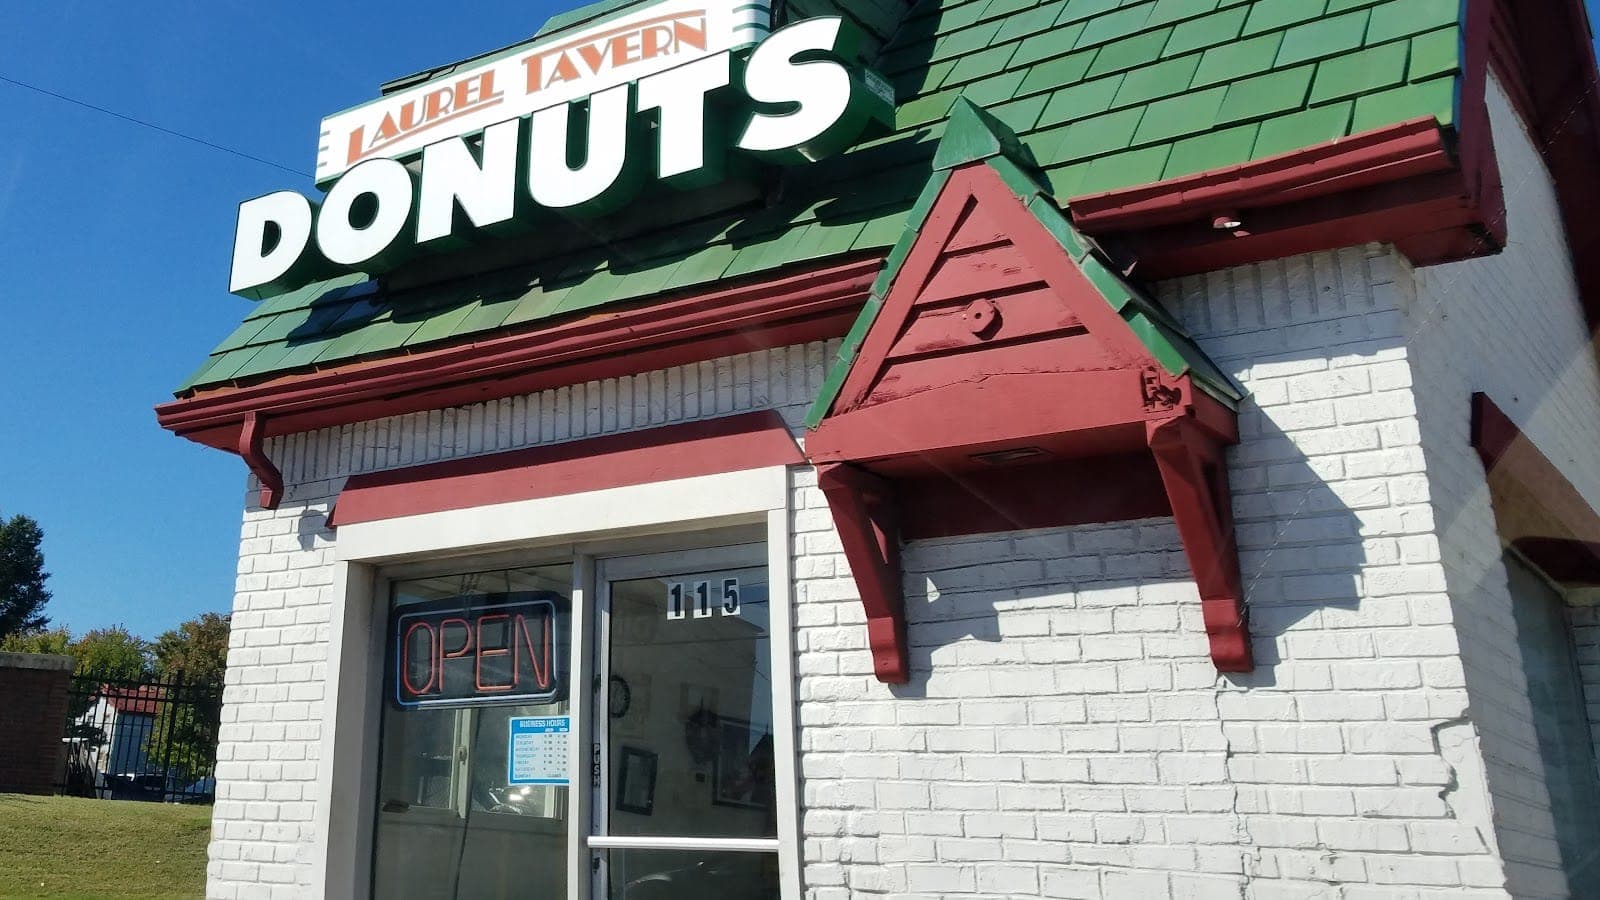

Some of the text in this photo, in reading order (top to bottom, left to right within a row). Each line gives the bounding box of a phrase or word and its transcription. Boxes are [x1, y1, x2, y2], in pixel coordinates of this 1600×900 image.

[346, 17, 706, 165] LAUREL TAVERN
[229, 15, 851, 294] DONUTS
[670, 578, 738, 617] 115
[402, 613, 550, 695] OPEN
[519, 719, 566, 728] BUSINESS HOURS
